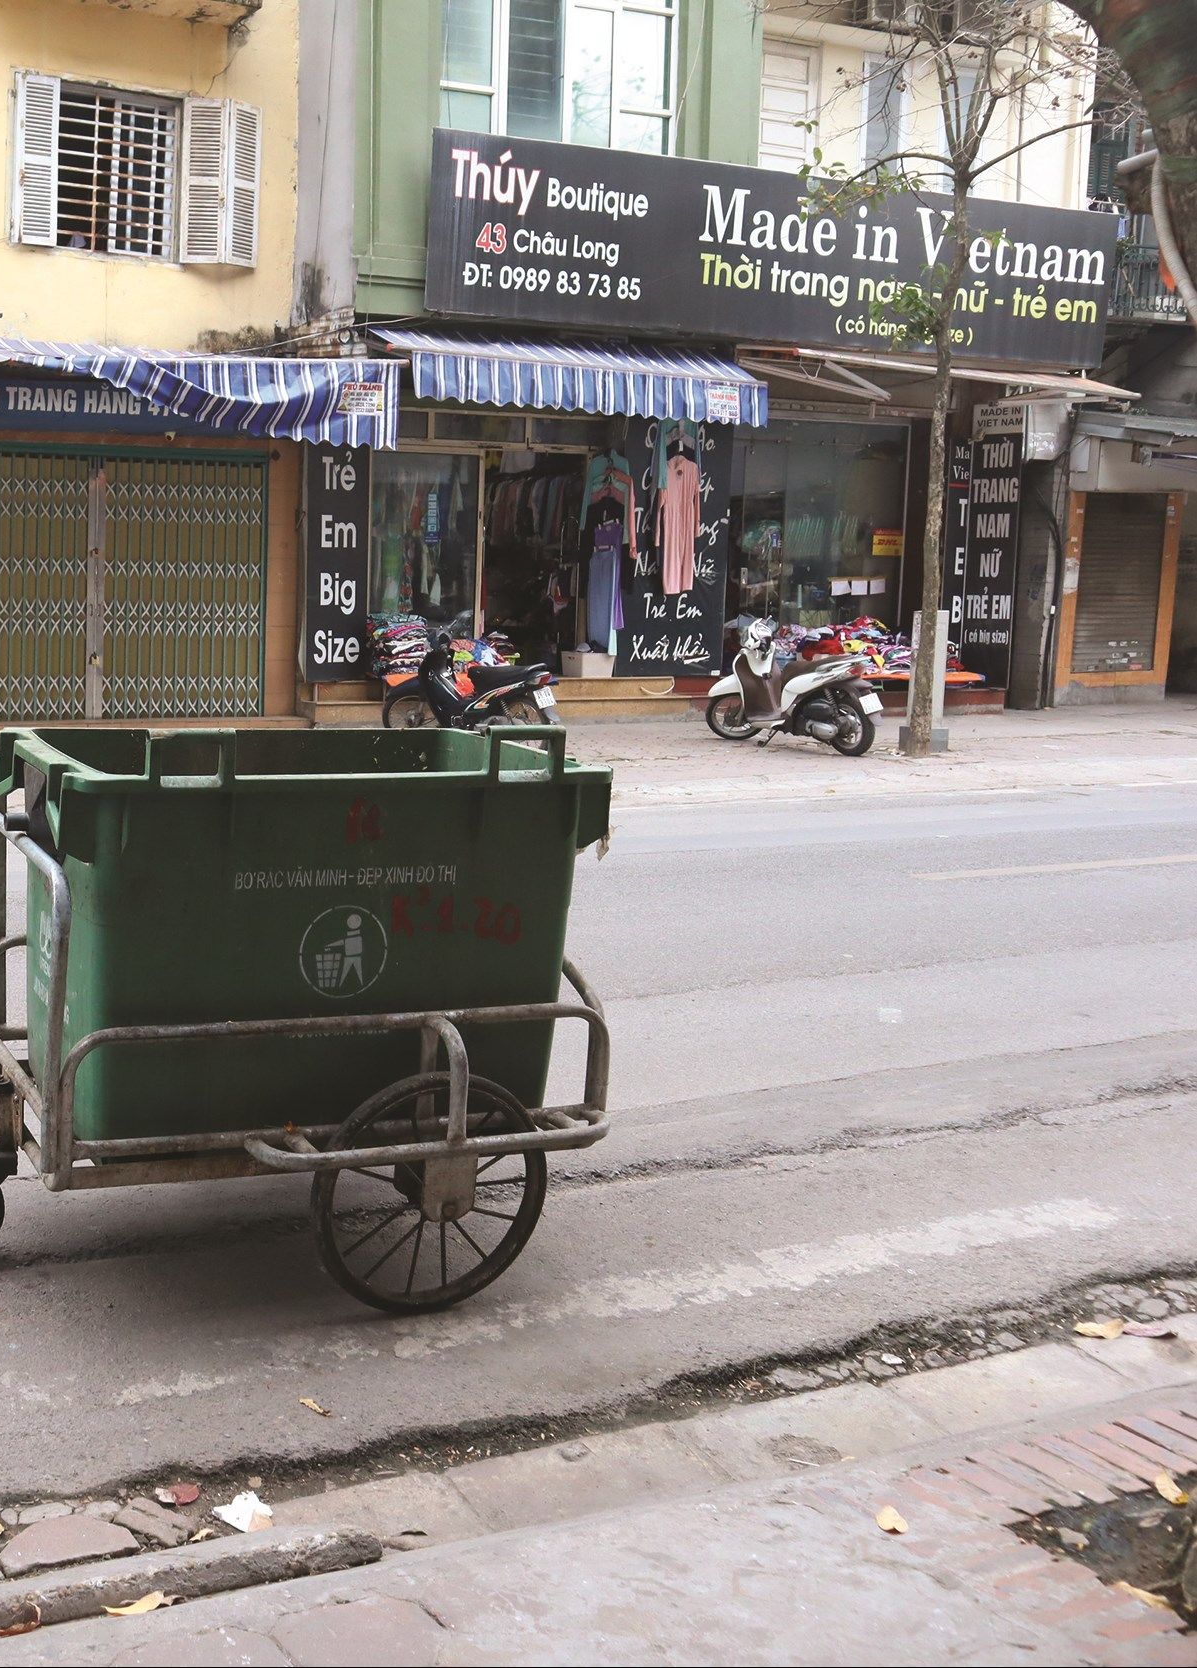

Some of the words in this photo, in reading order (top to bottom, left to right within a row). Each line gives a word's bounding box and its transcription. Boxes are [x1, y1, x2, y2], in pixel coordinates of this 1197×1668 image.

[451, 148, 541, 216] Thúy
[547, 177, 649, 221] Boutique
[476, 222, 507, 254] 43
[513, 229, 568, 257] Châu
[573, 235, 620, 267] Long
[699, 184, 837, 257] Made
[852, 205, 899, 264] in
[916, 206, 1105, 285] Vetnam
[462, 262, 493, 288] ĐT:
[499, 266, 551, 292] 0989
[556, 270, 581, 295] 83
[587, 273, 611, 298] 73
[617, 276, 641, 301] 85
[700, 253, 763, 290] Thời
[770, 261, 850, 308] trang
[1013, 284, 1048, 320] trẻ
[1055, 298, 1097, 323] em
[6, 387, 76, 413] TRANG
[980, 407, 1009, 416] MADE
[1011, 406, 1021, 415] IN
[977, 419, 999, 428] VIET
[1001, 418, 1023, 426] NAM
[983, 437, 1014, 468] THỜI
[322, 451, 356, 491] Trẻ
[973, 477, 1019, 504] TRANG
[321, 514, 357, 548] Em
[976, 513, 1011, 538] NAM
[979, 548, 1002, 578] NỮ
[320, 573, 356, 615] Big
[676, 593, 703, 620] Em
[966, 586, 989, 619] TRẺ
[991, 594, 1012, 620] EM
[313, 629, 360, 664] Size
[979, 629, 991, 645] big
[287, 866, 313, 887] VĂN
[315, 868, 347, 887] MINH
[356, 867, 383, 889] ĐẸP
[384, 866, 414, 884] XINH
[438, 864, 457, 886] THỊ
